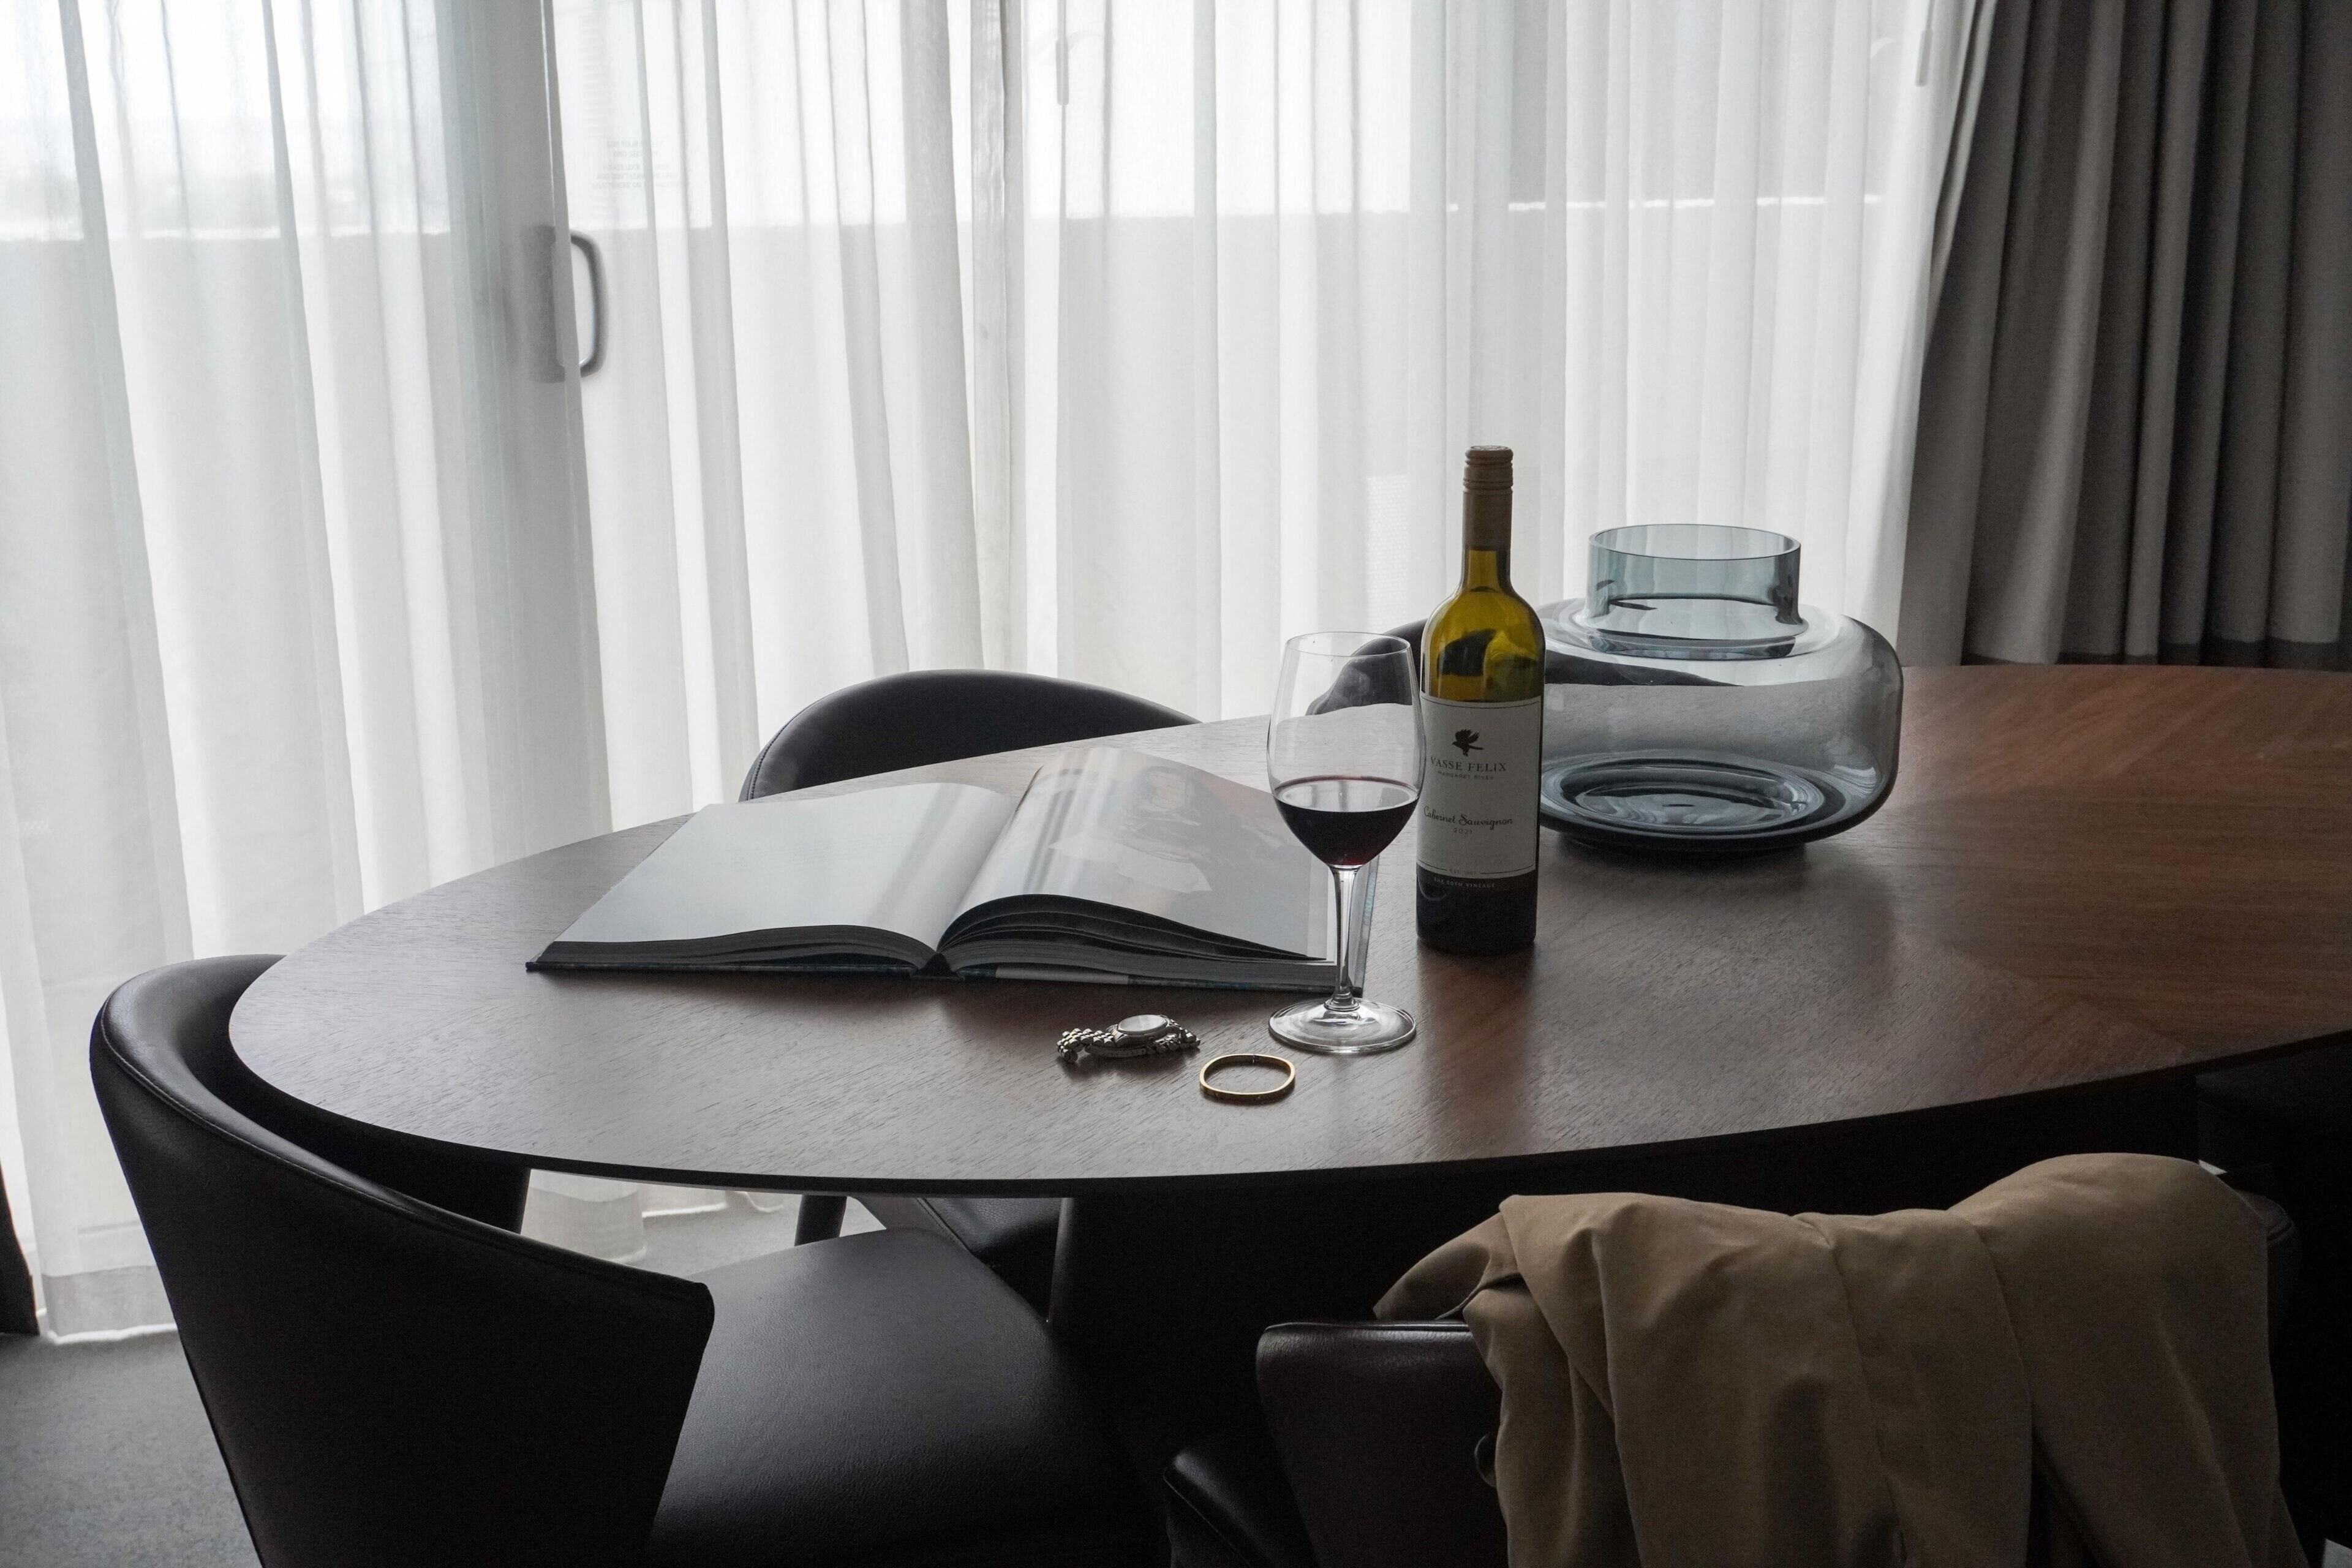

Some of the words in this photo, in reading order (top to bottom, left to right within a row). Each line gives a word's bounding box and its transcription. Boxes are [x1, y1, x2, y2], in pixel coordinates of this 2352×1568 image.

[1431, 756, 1463, 771] VASSE
[1468, 763, 1506, 772] FELIX
[1438, 771, 1470, 780] MARGARET
[1423, 805, 1455, 824] Cabernet
[1459, 813, 1512, 831] Sauvignon
